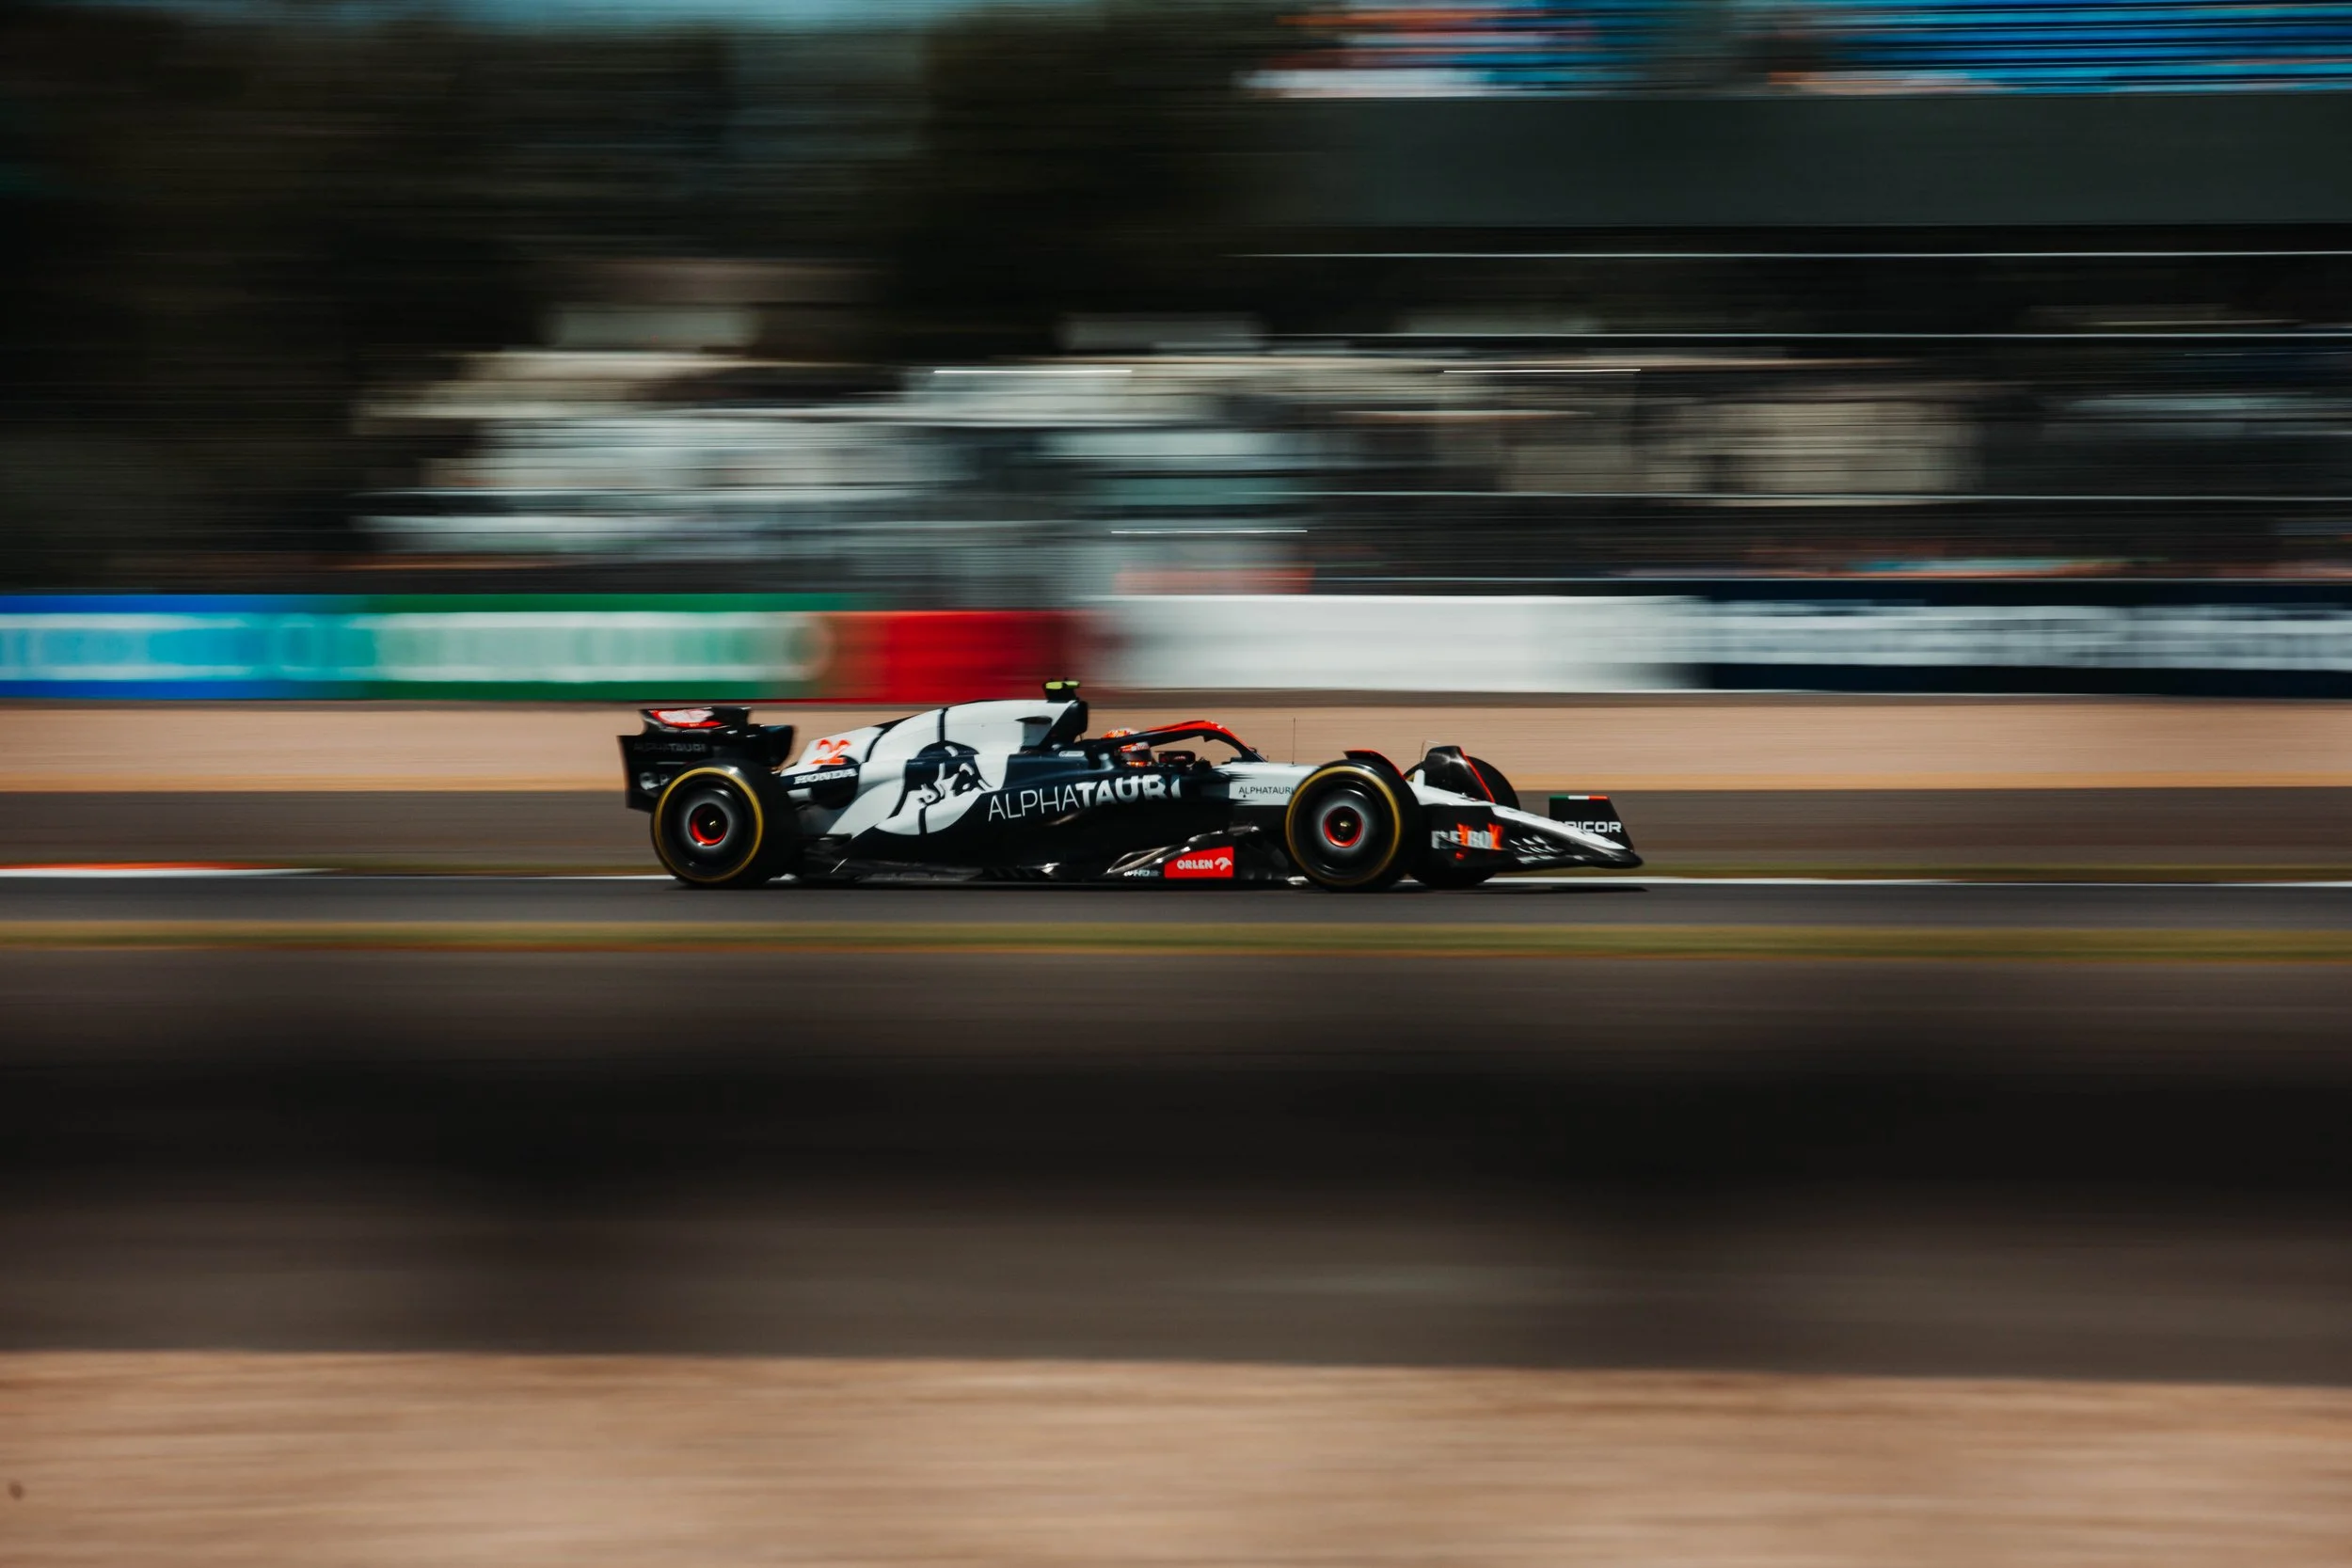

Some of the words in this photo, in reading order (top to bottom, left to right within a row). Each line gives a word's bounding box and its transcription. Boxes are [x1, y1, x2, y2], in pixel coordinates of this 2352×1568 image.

[794, 768, 858, 784] HONDA
[988, 773, 1183, 821] ALPHATAURI
[1238, 786, 1295, 795] ALPHATAURI
[1176, 859, 1214, 870] ORLEN
